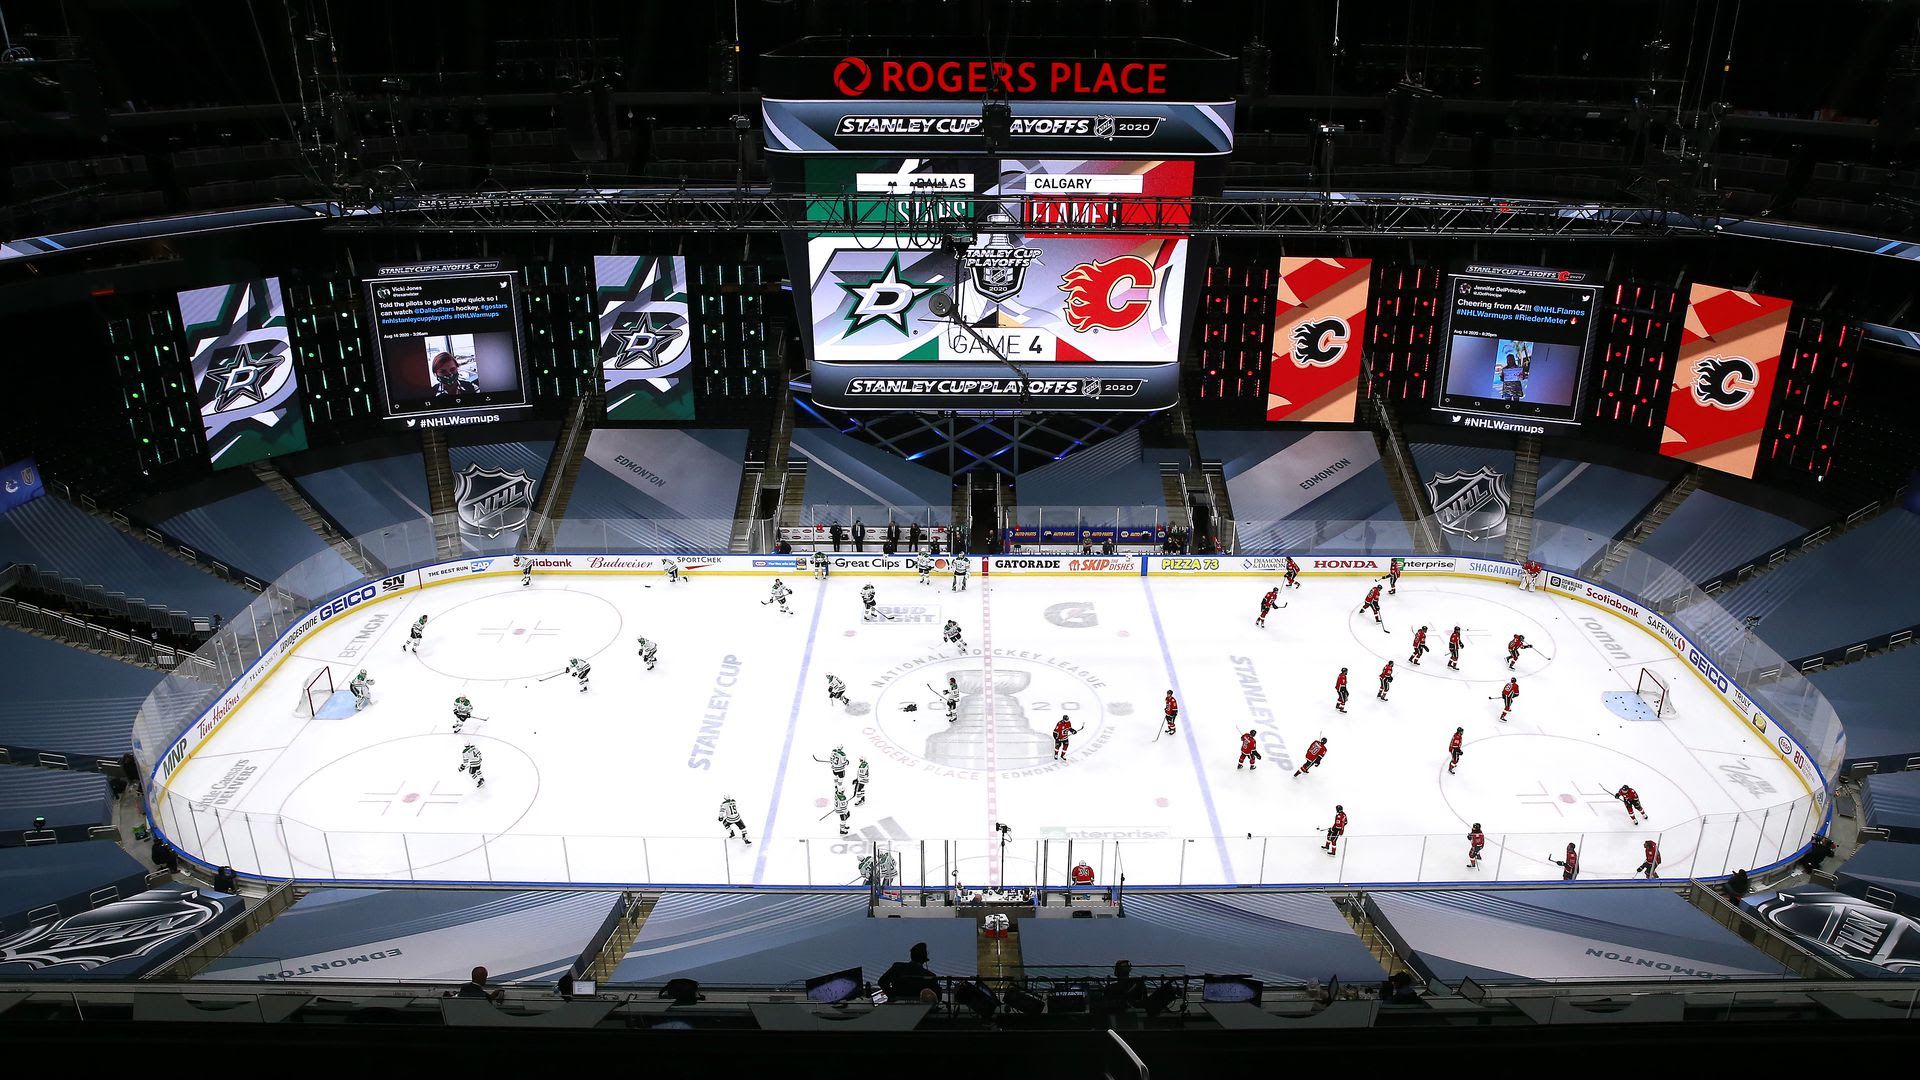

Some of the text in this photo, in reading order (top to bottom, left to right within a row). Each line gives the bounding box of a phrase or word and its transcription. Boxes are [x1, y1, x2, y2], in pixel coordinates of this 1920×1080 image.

[882, 61, 1168, 94] ROGERS PLACE
[842, 118, 936, 134] STANLEY
[936, 118, 980, 134] CUP
[1119, 123, 1150, 131] 2020
[917, 178, 966, 189] DALLAS
[1034, 178, 1092, 189] CALGARY
[1014, 249, 1042, 258] CUP
[380, 267, 415, 275] STANLEY
[431, 264, 471, 272] PLAYOFFS
[966, 259, 1031, 267] PLAYOFFS
[1468, 266, 1501, 274] STANLEY
[1516, 270, 1557, 278] PLAYOFFS
[468, 296, 486, 304] quick
[1457, 299, 1585, 316] Cheering from AZ!!! @NHLFlames
[414, 306, 455, 314] @DallasStars
[456, 304, 480, 312] hockey.
[481, 303, 509, 311] #gostars
[453, 311, 500, 320] #NHLWarmups
[1456, 309, 1568, 324] #NHLWarmups #RiederMeter
[953, 335, 1043, 354] GAME 4
[851, 380, 936, 393] STANLEY
[938, 380, 977, 393] CUP
[420, 413, 500, 428] #NHLWarmups
[1464, 417, 1544, 435] #NHLWarmups
[613, 455, 667, 488] EDMONTON
[1299, 458, 1352, 490] EDMONTON
[473, 484, 524, 524] NHL
[1443, 484, 1488, 522] NHL
[471, 560, 490, 572] SAP
[513, 557, 572, 567] Stiabank
[587, 556, 653, 569] Budweiser
[835, 558, 870, 568] Great
[871, 558, 900, 569] Clips
[995, 560, 1060, 569] GATORADE
[1080, 559, 1110, 571] SKIP
[1109, 562, 1135, 571] DISHES
[1162, 559, 1220, 570] PIZZA 73
[1313, 560, 1379, 569] HONDA
[1398, 559, 1455, 571] enterprise
[1469, 562, 1523, 577] SHAGANAPP
[440, 568, 456, 576] BEST
[456, 565, 469, 573] RUN
[382, 574, 406, 588] SN
[319, 585, 377, 622] GEICO
[879, 606, 926, 615] BUD
[1586, 587, 1639, 618] Scotiabank
[279, 615, 318, 654] BRIDGESTONE
[338, 612, 390, 659] BETMGM
[1578, 615, 1632, 660] roman
[1646, 615, 1679, 648] SAFEWAY
[249, 665, 265, 682] TELUS
[872, 653, 950, 689] NATIONAL
[1047, 657, 1107, 690] LEAGUE
[1688, 648, 1729, 694] GEICO
[1734, 689, 1752, 709] TRULY
[197, 693, 240, 740] Tim Hortons
[688, 654, 743, 771] STANLEY CUP
[1230, 654, 1294, 772] STANLEY CUP
[162, 738, 187, 781] MNP
[1793, 750, 1804, 769] 80
[923, 765, 980, 781] PLACE
[213, 765, 258, 805] DELIVERS
[729, 804, 738, 815] 15
[48, 913, 198, 949] NHL
[1838, 909, 1888, 955] NHL
[257, 948, 403, 981] EDMONTON
